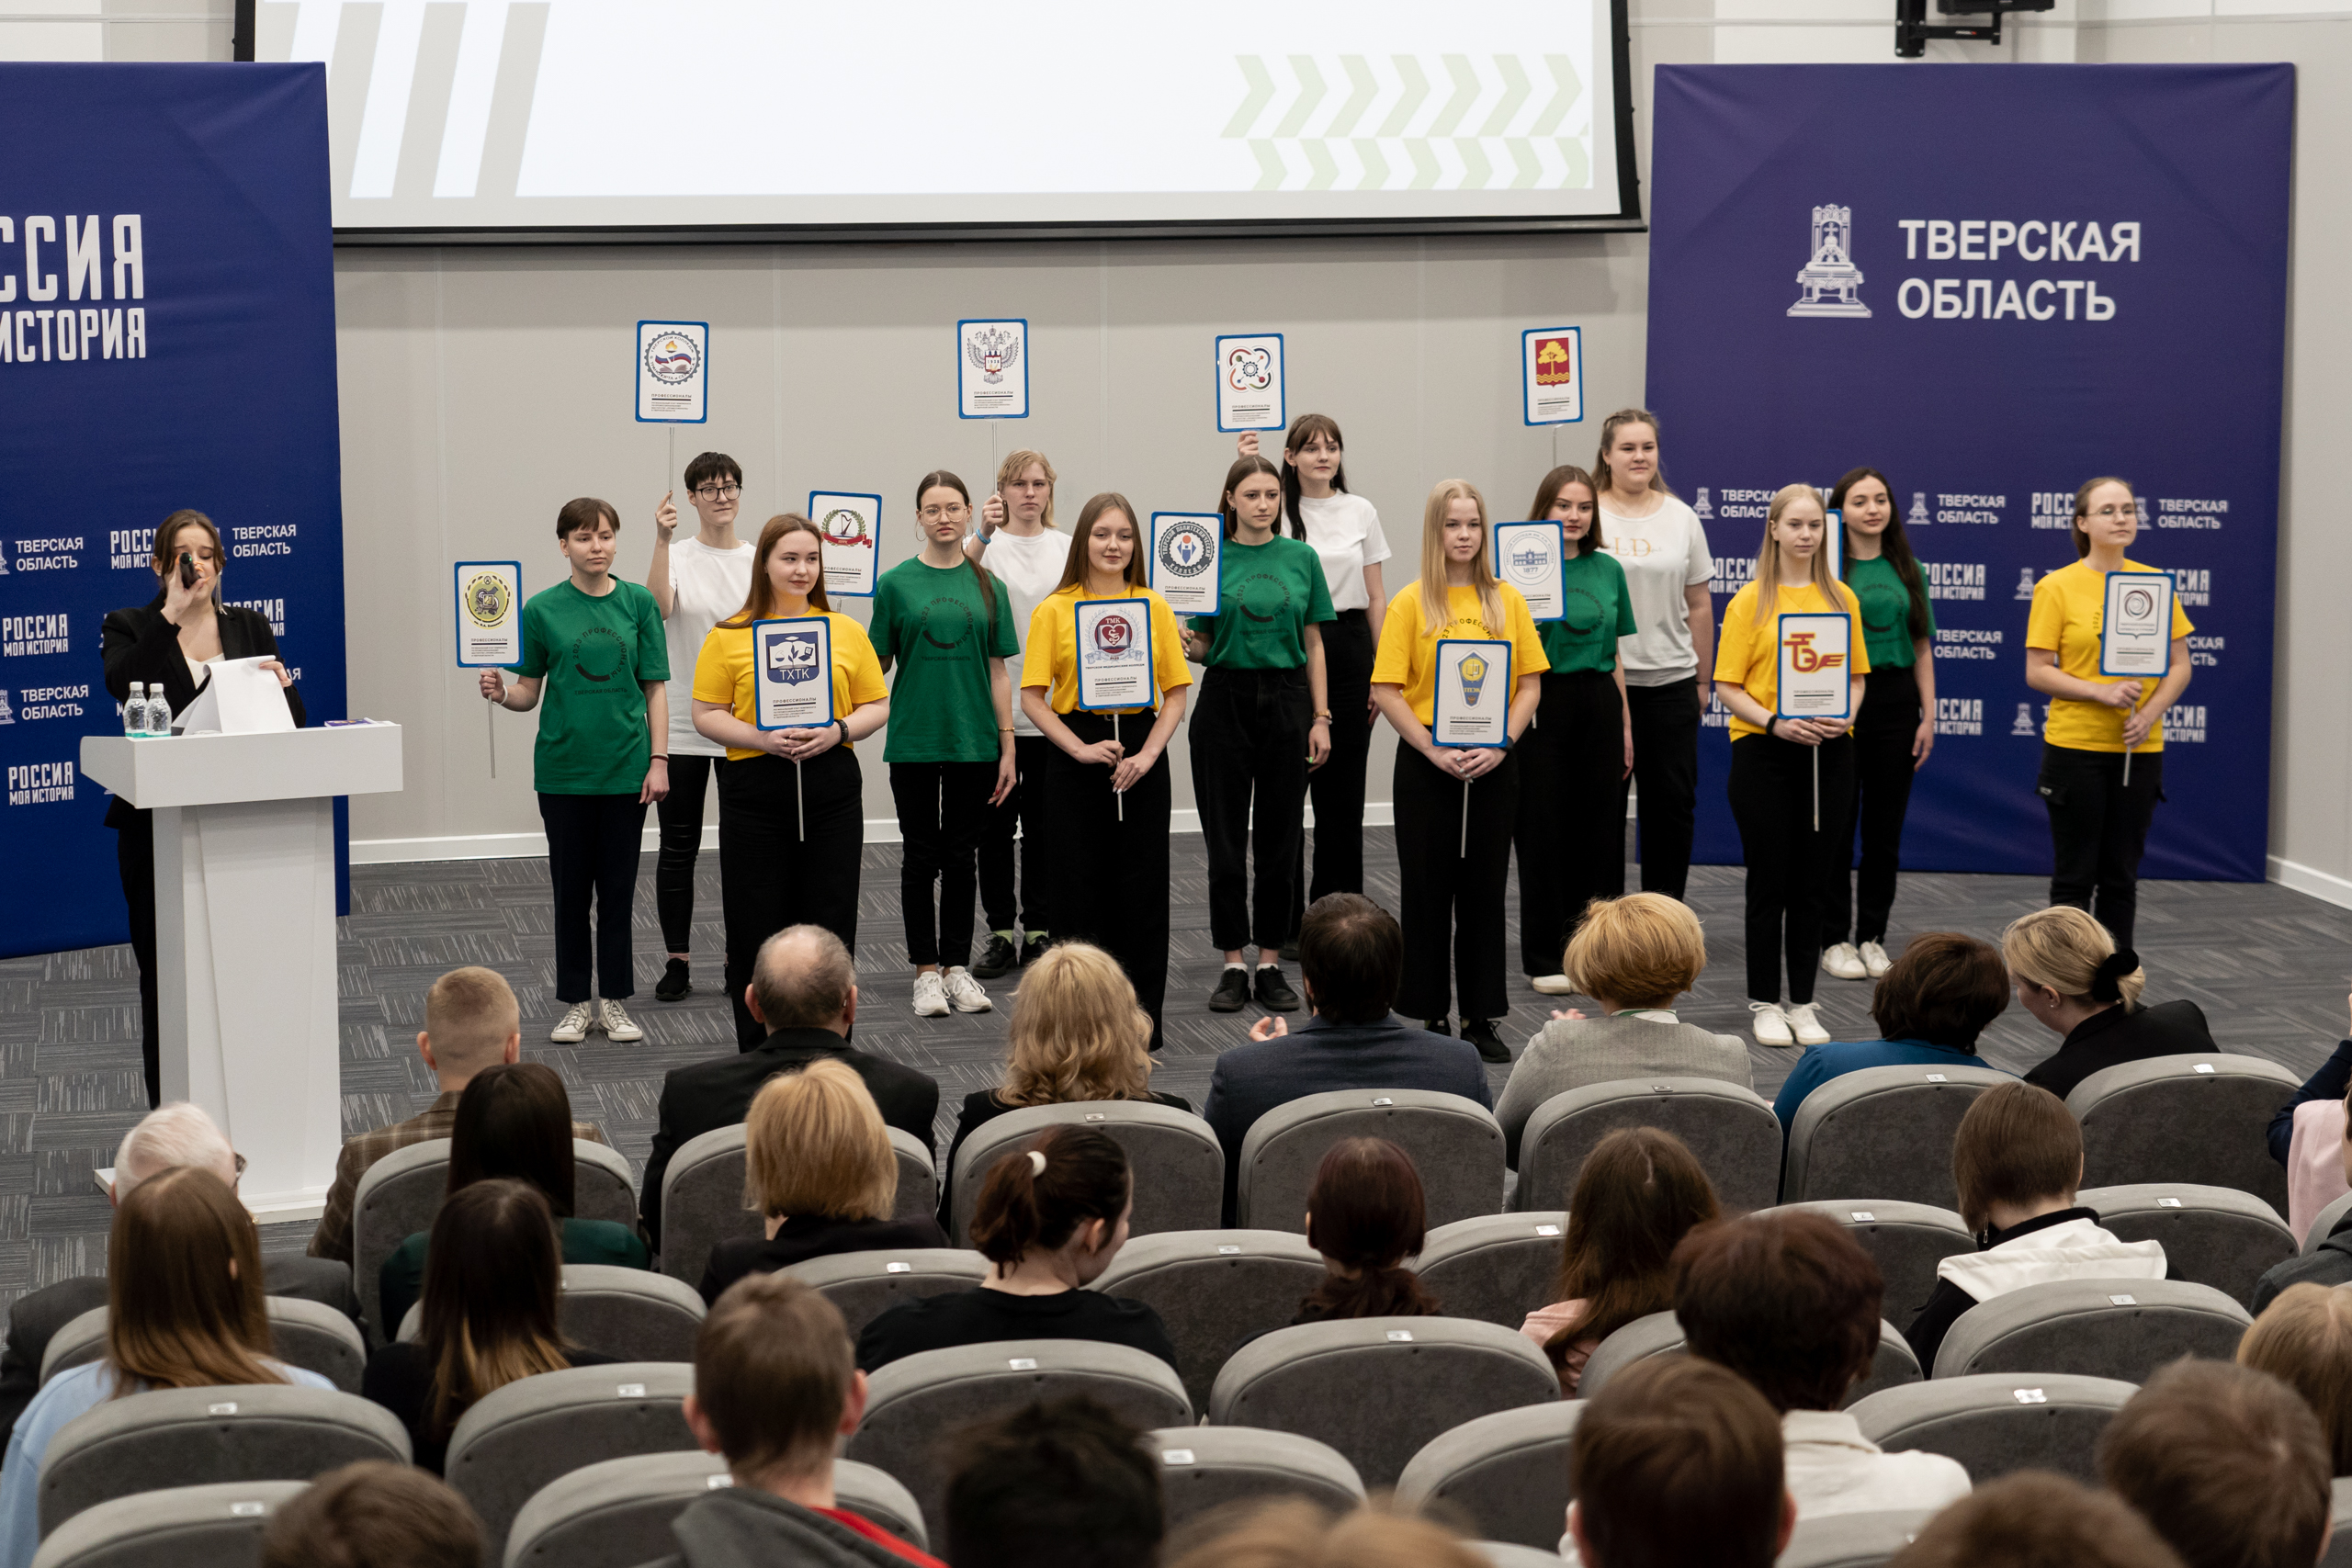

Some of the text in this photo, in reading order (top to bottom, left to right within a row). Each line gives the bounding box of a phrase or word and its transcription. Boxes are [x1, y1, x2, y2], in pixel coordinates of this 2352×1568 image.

[1898, 220, 2141, 262] ТВЕРСКАЯ
[1897, 278, 2116, 321] ОБЛАСТЬ
[1721, 489, 1778, 502] ТВЕРСКА
[1938, 494, 2006, 508] ТВЕРСКАЯ
[2031, 492, 2075, 514] РОСС
[1721, 505, 1770, 519] ОБЛАСТ
[2158, 499, 2228, 513] ТВЕРСКАЯ
[1937, 511, 1999, 525] ОБЛАСТЬ
[2158, 514, 2221, 529] ОБЛАСТЬ
[232, 525, 297, 540] ТВЕРСКАЯ
[16, 537, 84, 554] ТВЕРСКАЯ
[110, 528, 156, 554] РОСС
[233, 542, 290, 558] ОБЛАСТЬ
[17, 556, 78, 571] ОБЛАСТЬ
[1712, 558, 1757, 580] ОССИ
[1246, 573, 1291, 619] ПРОФЕССИОНАЛЫ
[3, 614, 68, 641] РОССИЯ
[921, 597, 974, 647] 2023 ПРОФЕССИОНАЛЫ
[1442, 629, 1450, 639] 23
[1936, 630, 2003, 643] ТВЕРСКАЯ
[572, 627, 628, 678] 2023 ПРОФЕССИОНАЛЫ
[1934, 646, 1996, 660] ОБЛАСТЬ
[779, 668, 810, 681] ТХТК
[21, 685, 89, 703] ТВЕРСКАЯ
[22, 705, 83, 720] ОБЛАСТЬ
[1933, 698, 1983, 720] ССИЯ
[2163, 705, 2206, 728] ССИЯ
[8, 761, 74, 790] РОССИЯ
